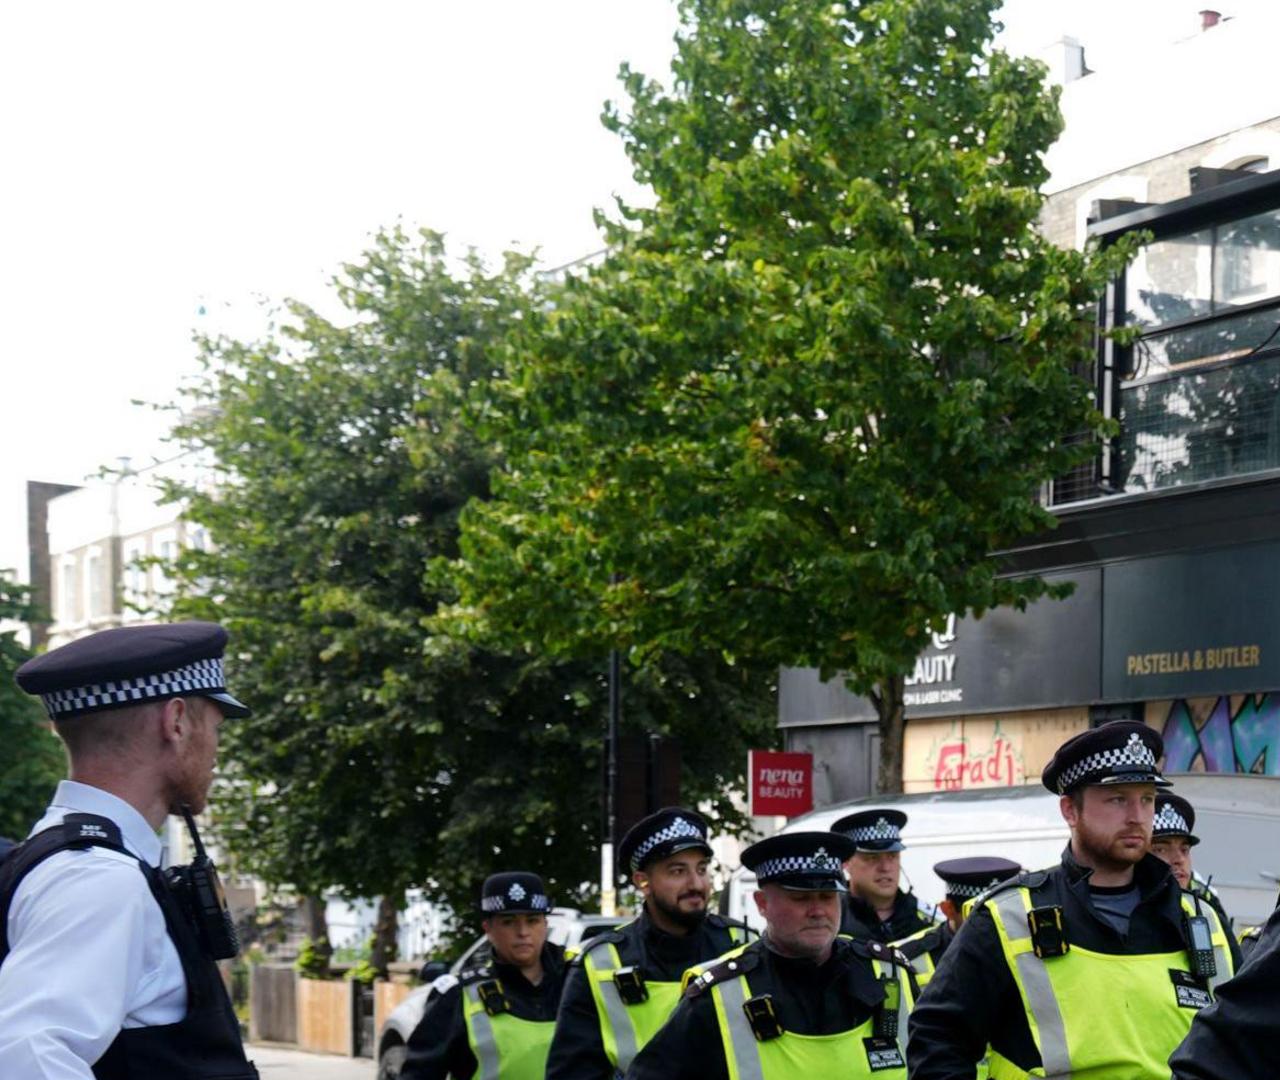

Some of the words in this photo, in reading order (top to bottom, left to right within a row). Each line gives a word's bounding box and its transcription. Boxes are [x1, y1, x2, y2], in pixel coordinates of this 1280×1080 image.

[1127, 651, 1190, 676] PASTELLA
[1193, 649, 1204, 671] &
[1206, 645, 1260, 670] BUTLER
[760, 767, 804, 786] nena
[759, 787, 803, 799] BEAUTY
